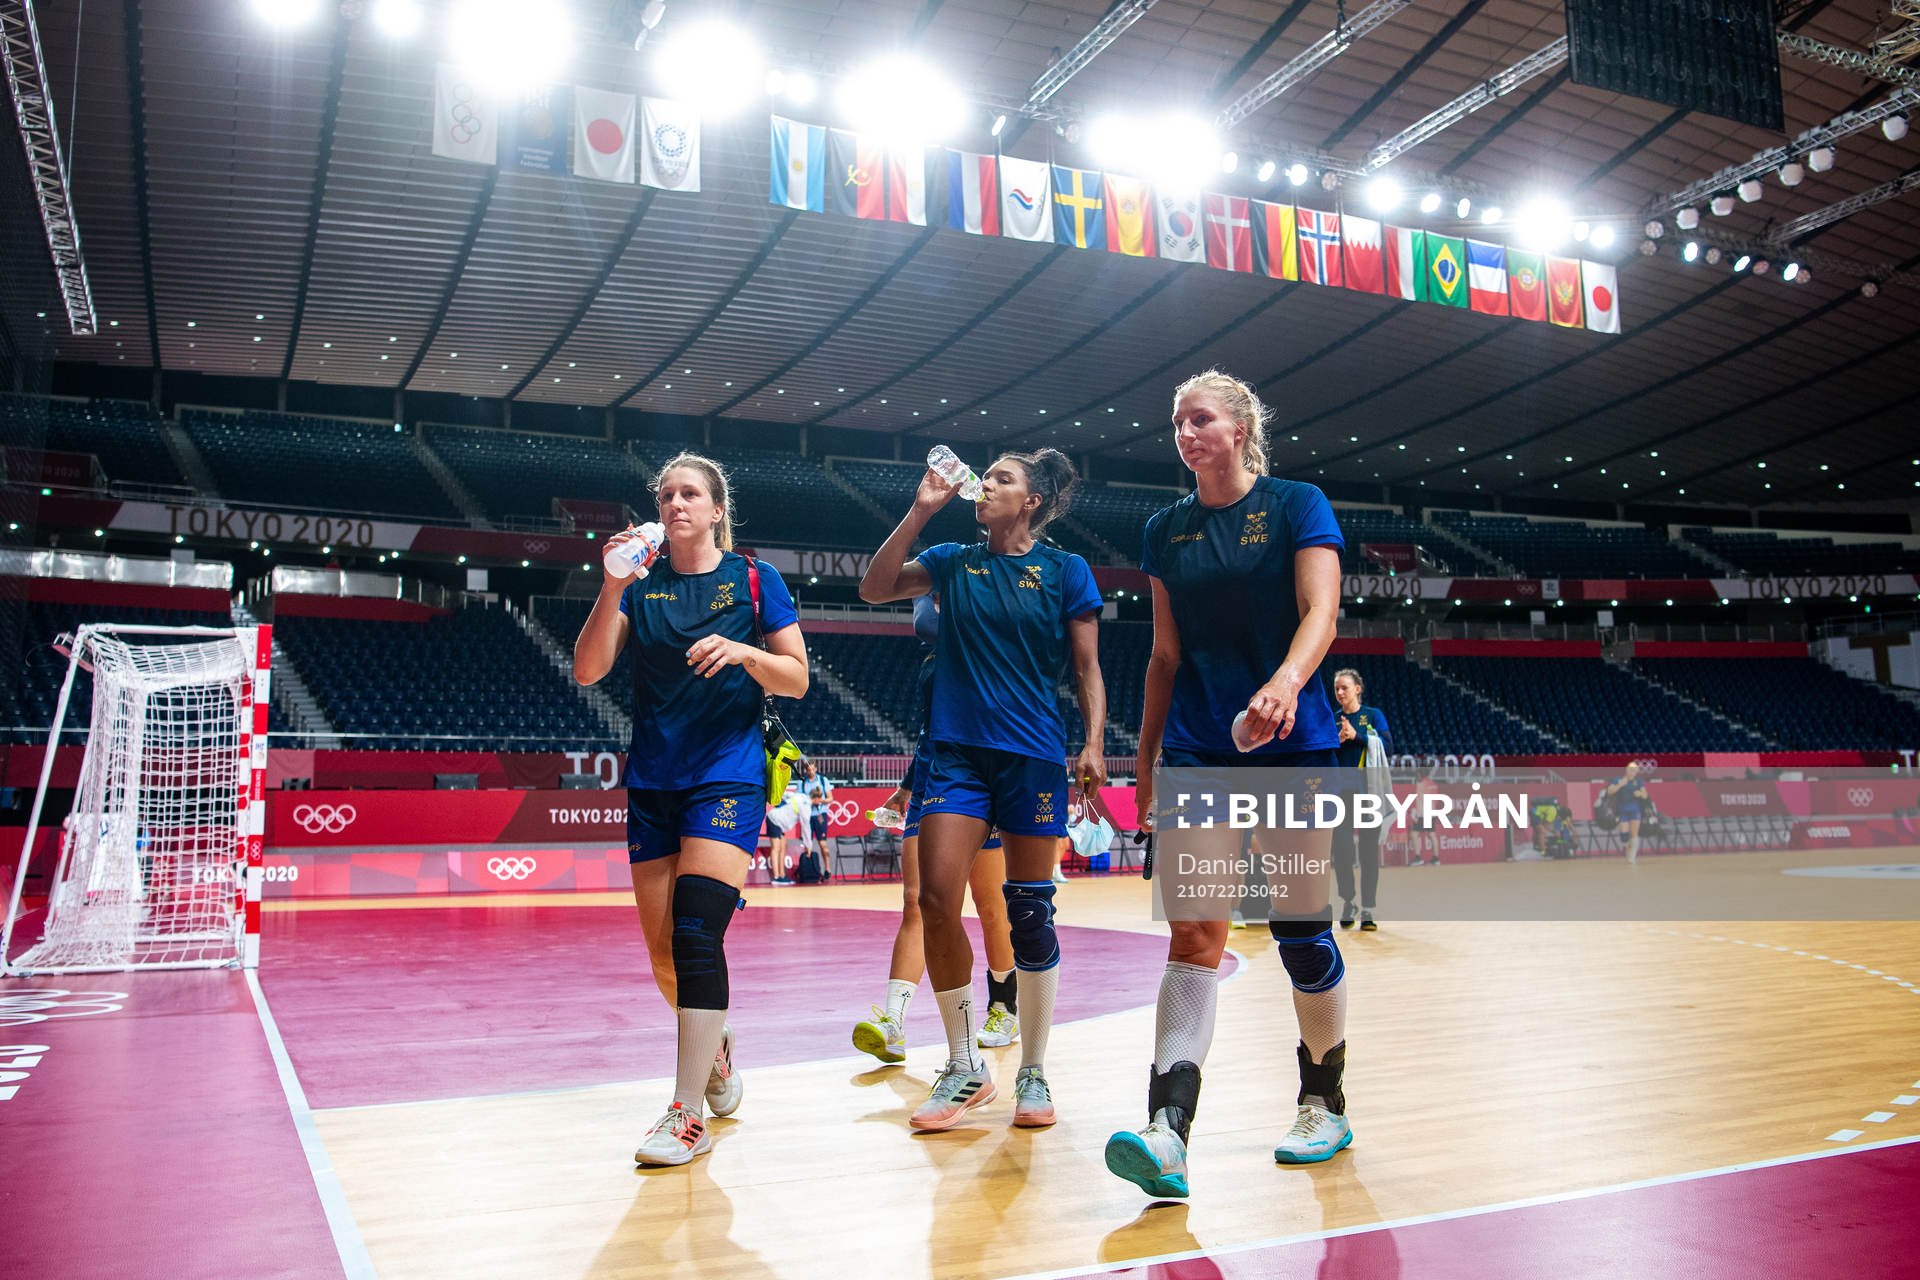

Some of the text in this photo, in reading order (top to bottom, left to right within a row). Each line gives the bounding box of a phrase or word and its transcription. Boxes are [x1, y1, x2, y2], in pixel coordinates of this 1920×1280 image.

[165, 505, 375, 549] TOKYO 2020
[1240, 533, 1269, 545] SWE
[1368, 577, 1422, 599] 2020
[1744, 575, 1887, 598] TOKYO 2020
[549, 808, 601, 824] TOKYO
[1301, 804, 1315, 815] SW
[711, 817, 737, 830] SWE
[1035, 814, 1055, 823] SWE
[1440, 835, 1484, 850] Emotion
